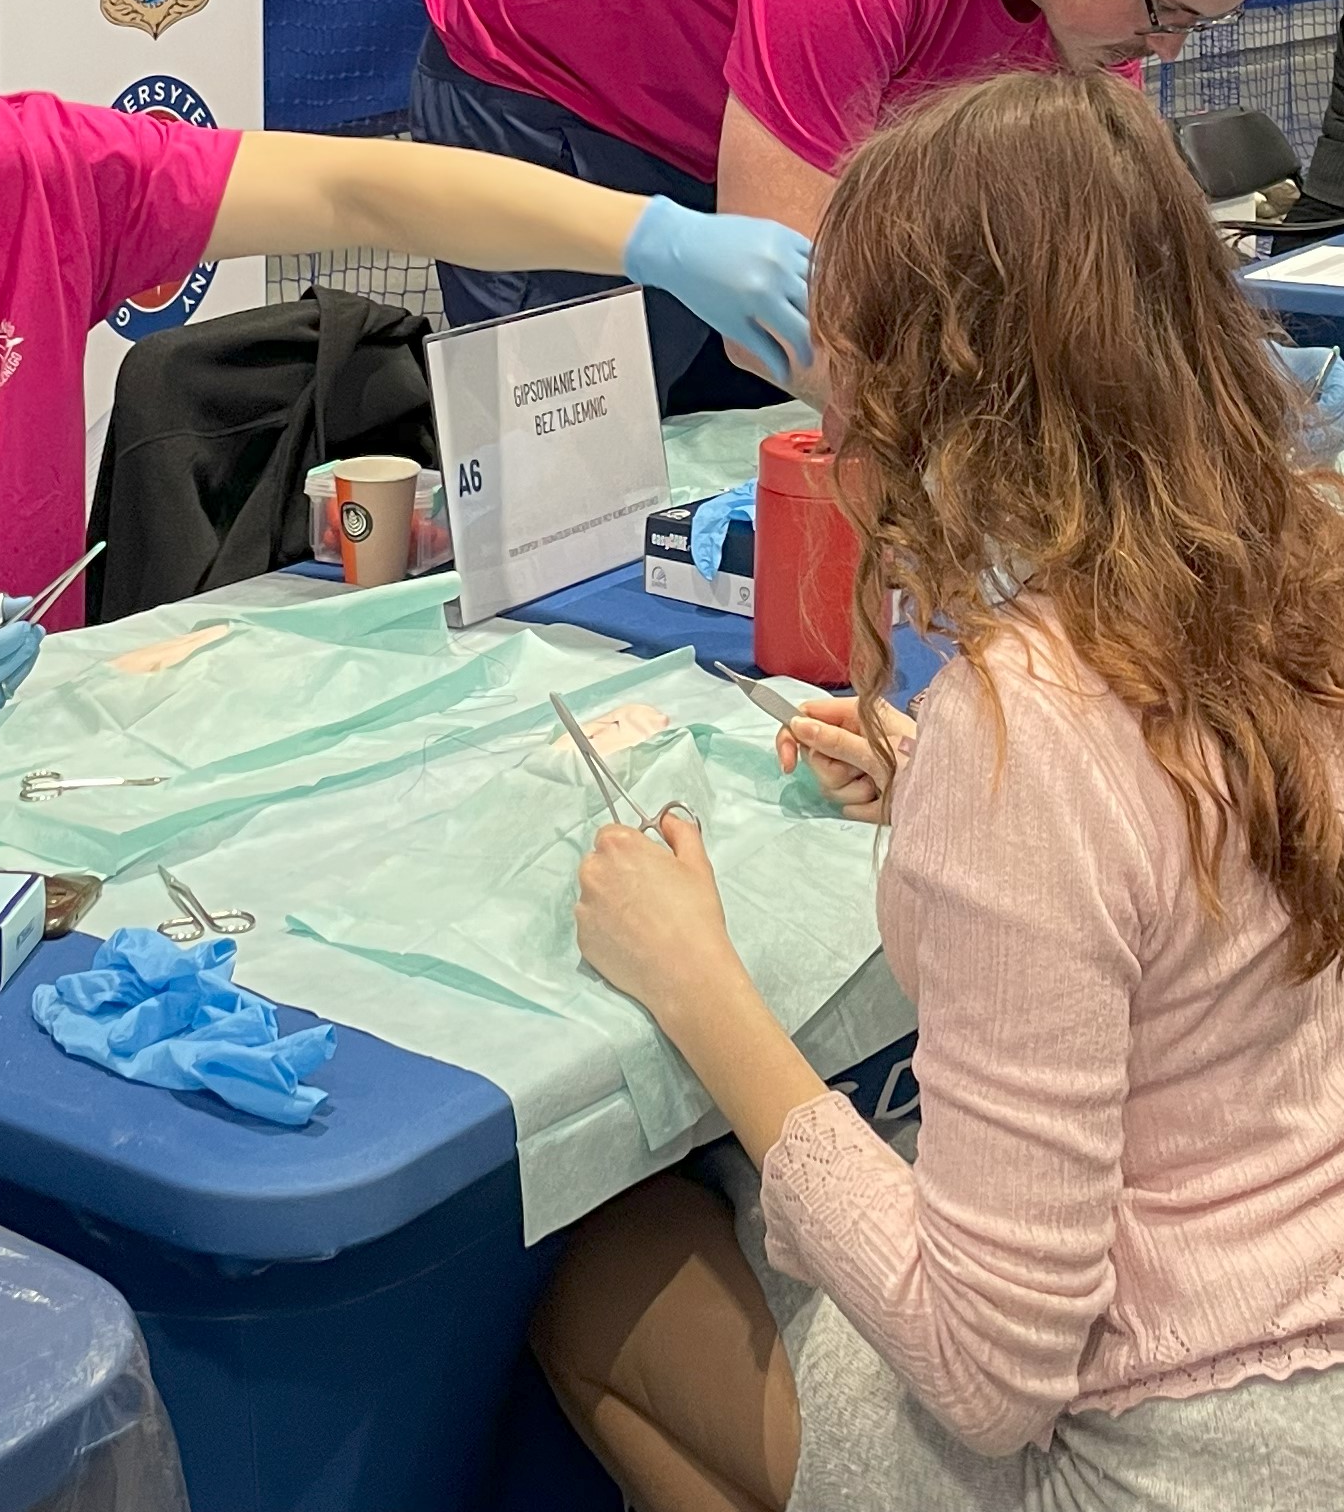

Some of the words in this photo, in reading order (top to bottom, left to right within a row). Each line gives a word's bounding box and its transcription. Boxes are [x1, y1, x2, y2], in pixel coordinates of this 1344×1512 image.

[513, 369, 577, 407] GIPSOWANIE
[577, 368, 583, 389] I
[583, 358, 618, 387] SZYCIE
[534, 411, 556, 435] BEZ
[557, 395, 608, 429] TAJEMNIC
[459, 459, 482, 498] A6
